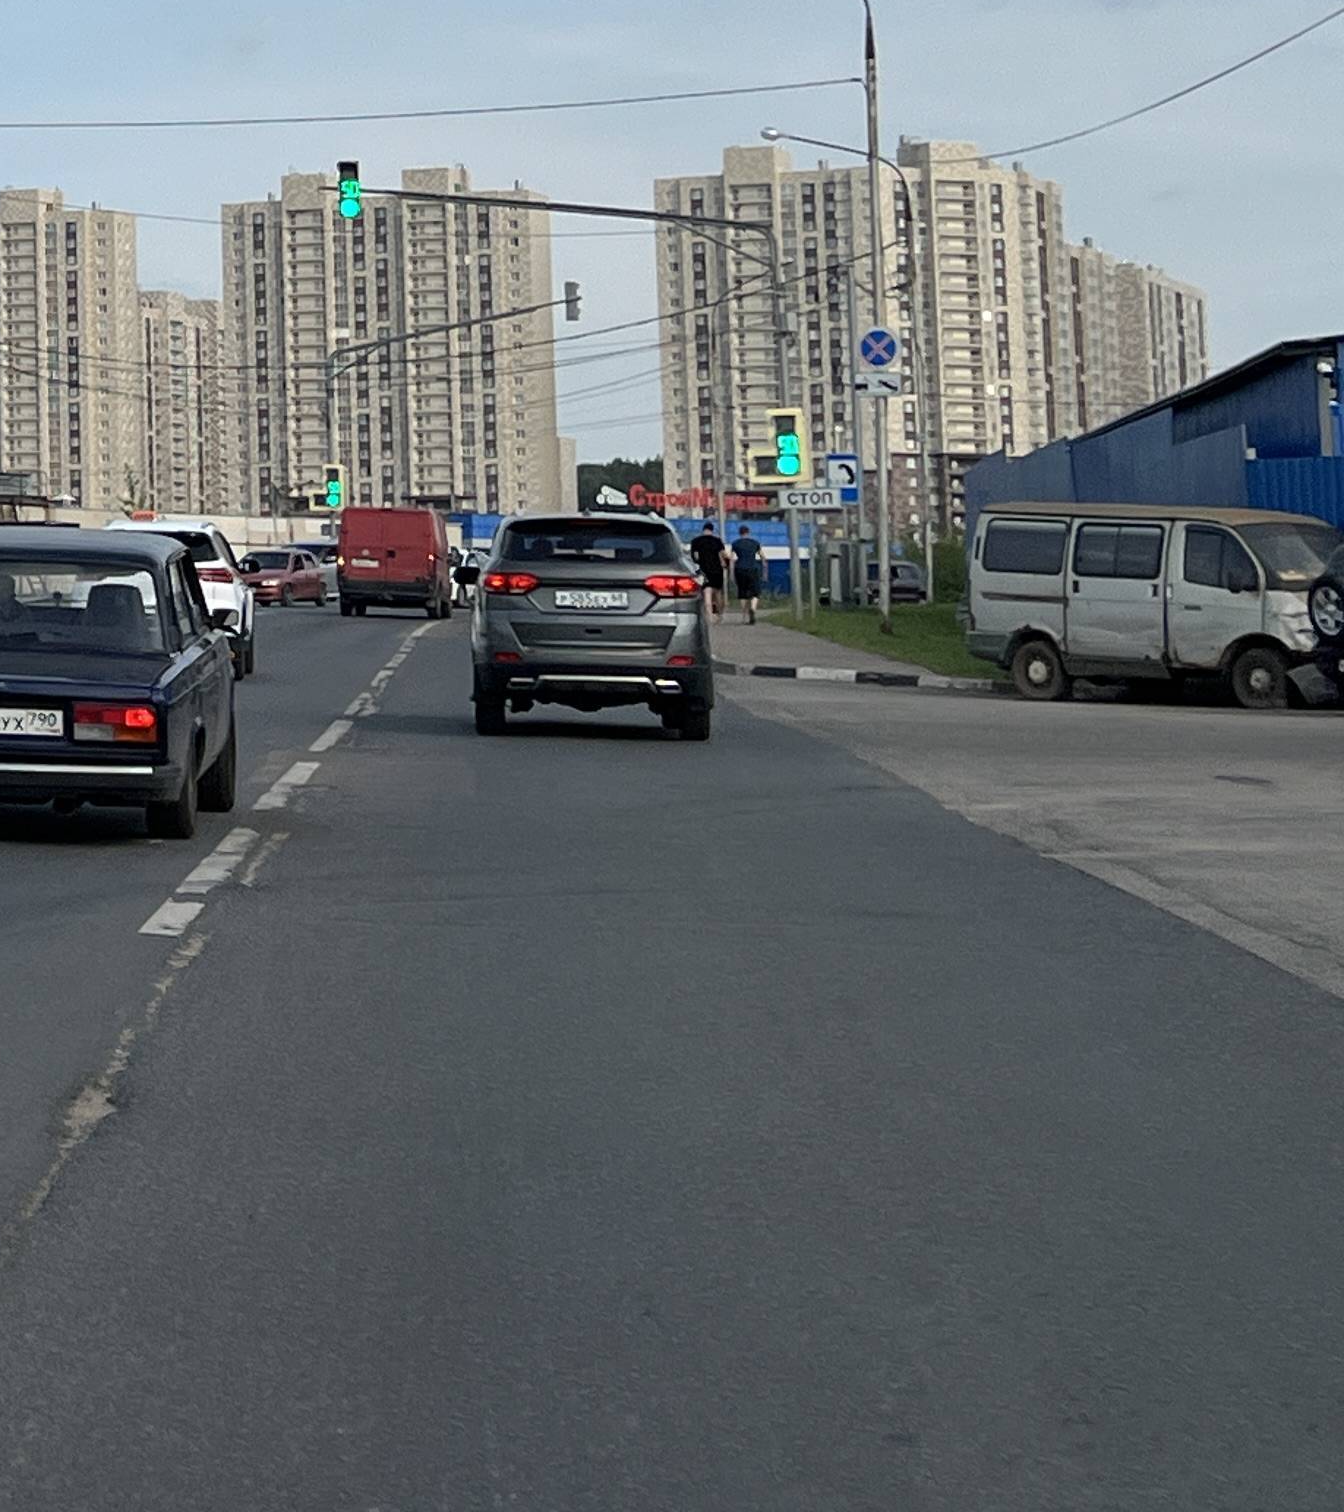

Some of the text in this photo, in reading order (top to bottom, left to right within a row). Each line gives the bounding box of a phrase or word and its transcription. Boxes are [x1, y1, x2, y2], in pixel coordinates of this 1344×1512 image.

[629, 484, 768, 512] СтройМркет
[787, 492, 833, 506] СТОП
[27, 712, 57, 727] 790
